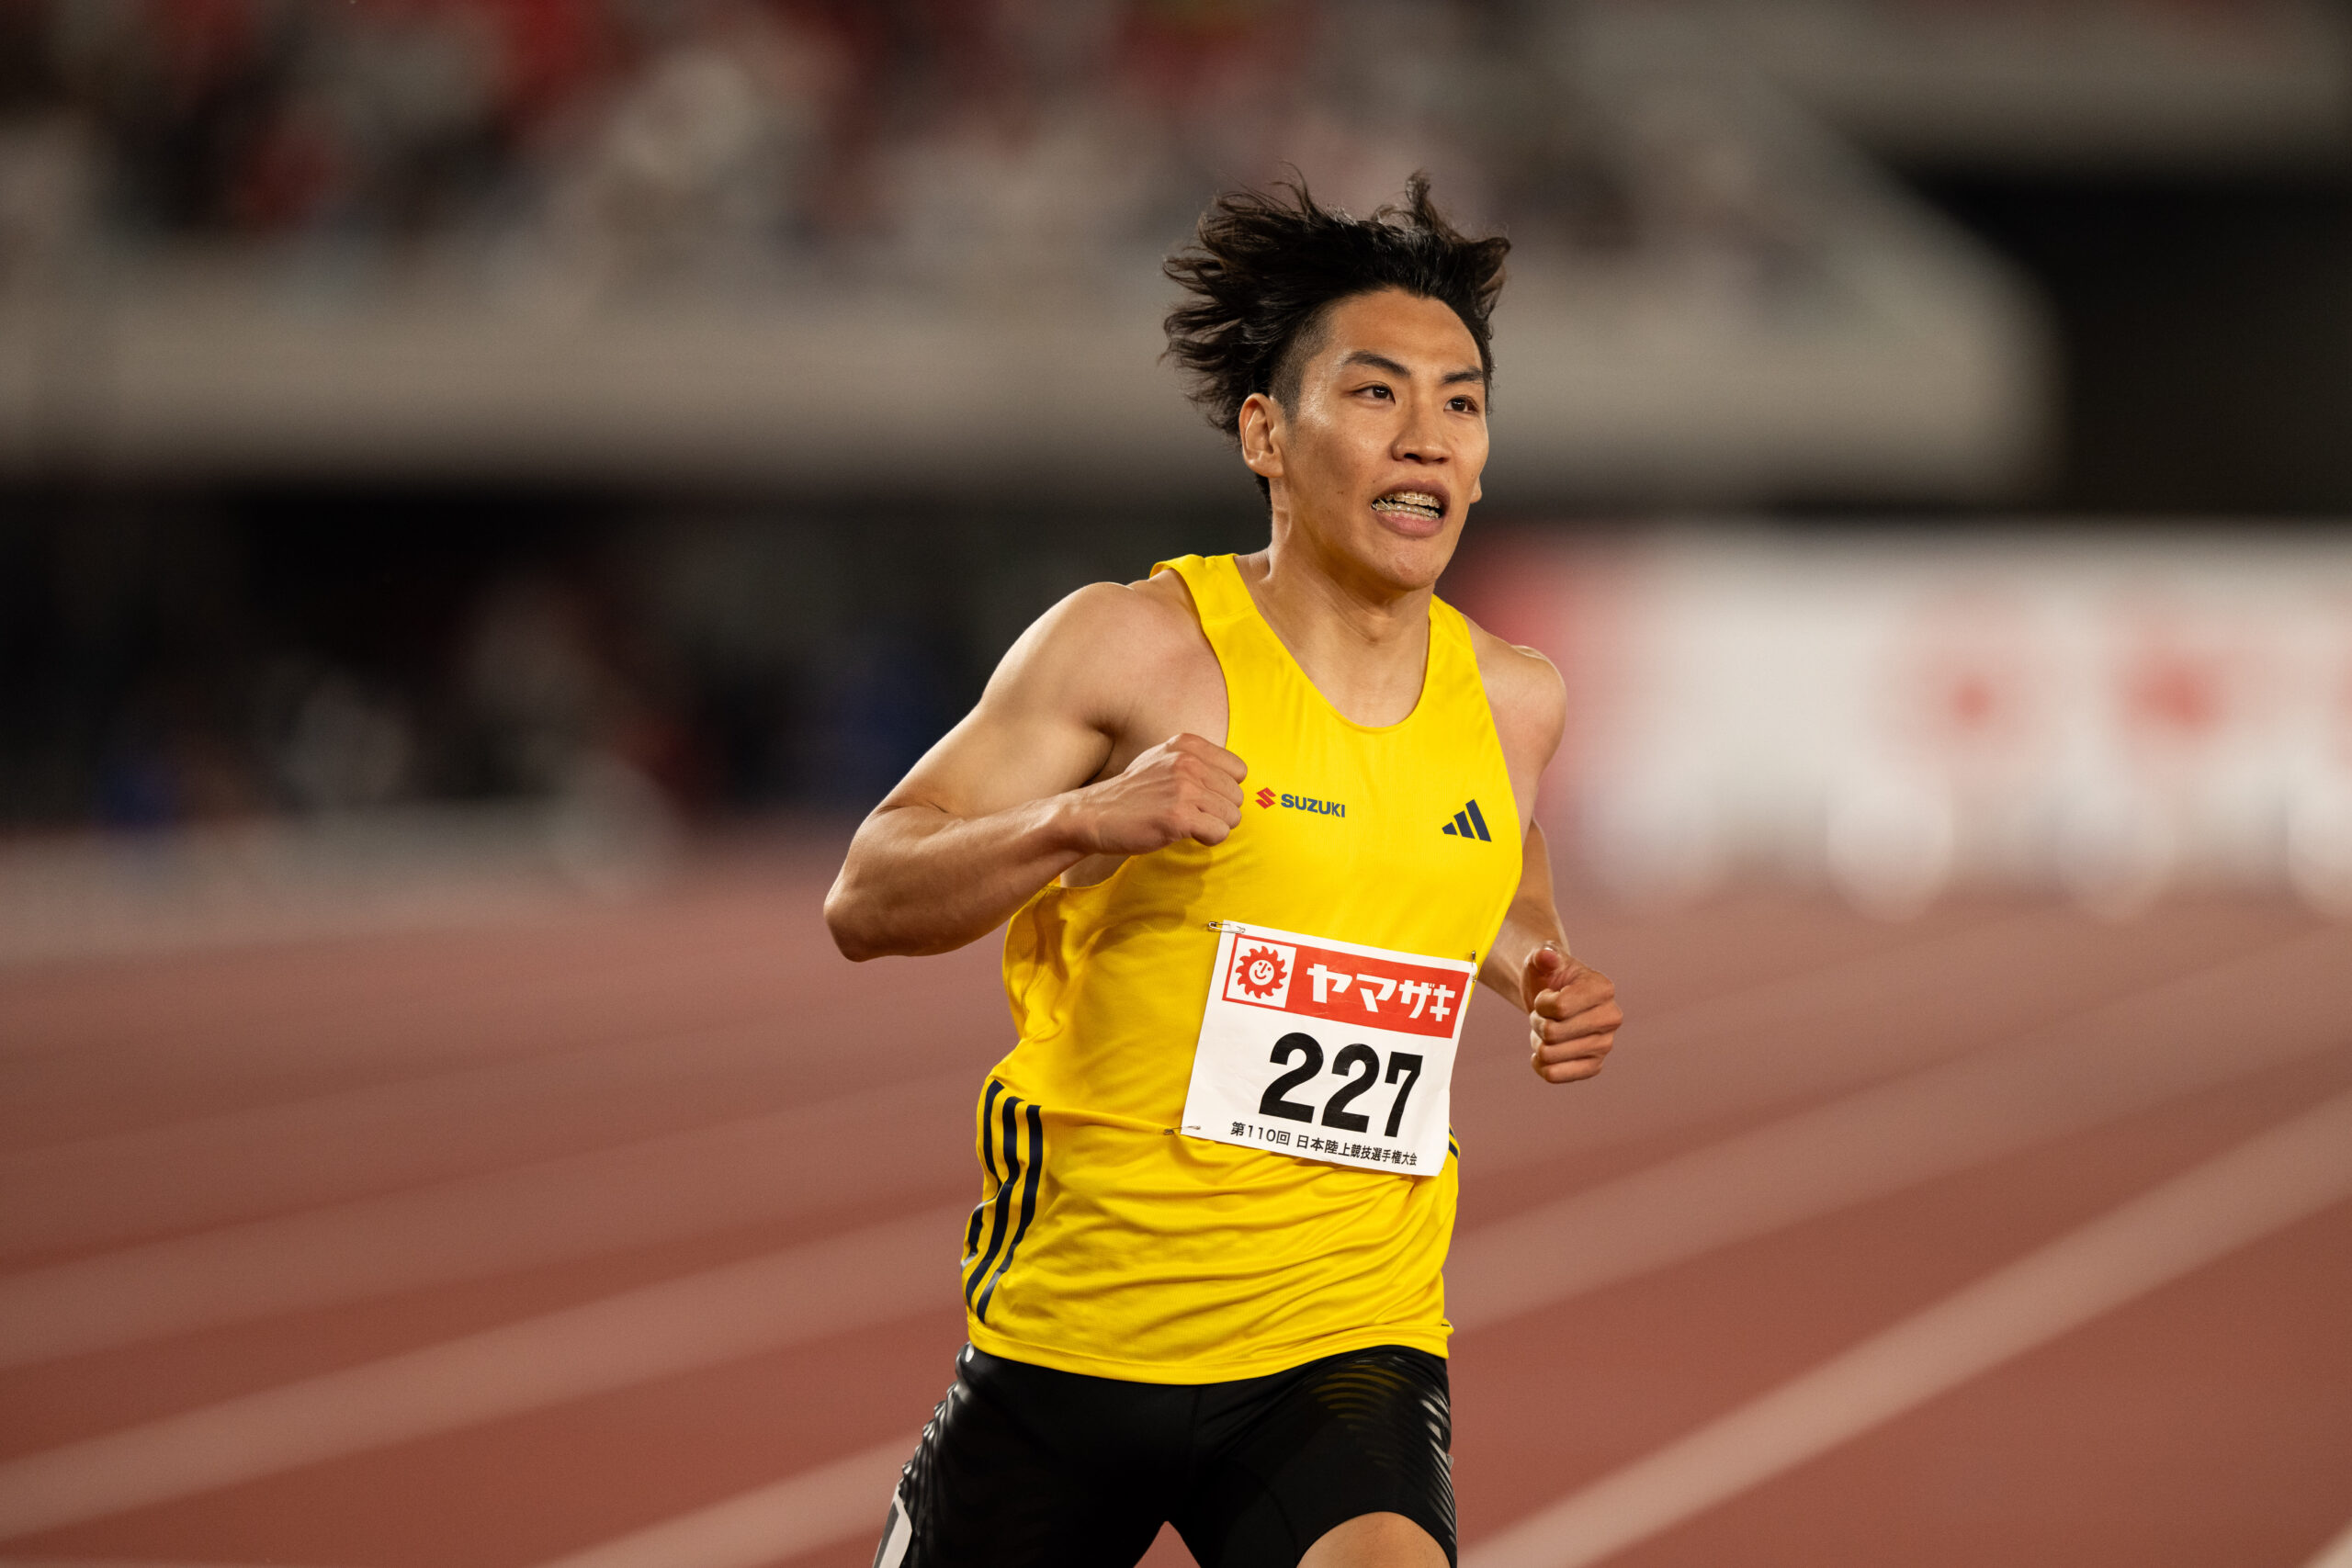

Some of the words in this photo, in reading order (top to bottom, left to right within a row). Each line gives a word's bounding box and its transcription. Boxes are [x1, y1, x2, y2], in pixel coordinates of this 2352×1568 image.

[1281, 794, 1346, 818] SUZUKI
[1306, 963, 1456, 1021] ヤマザキ
[1259, 1032, 1424, 1138] 227
[1230, 1121, 1291, 1145] 第110回
[1296, 1134, 1418, 1167] 日本陸上競技選手権大会
